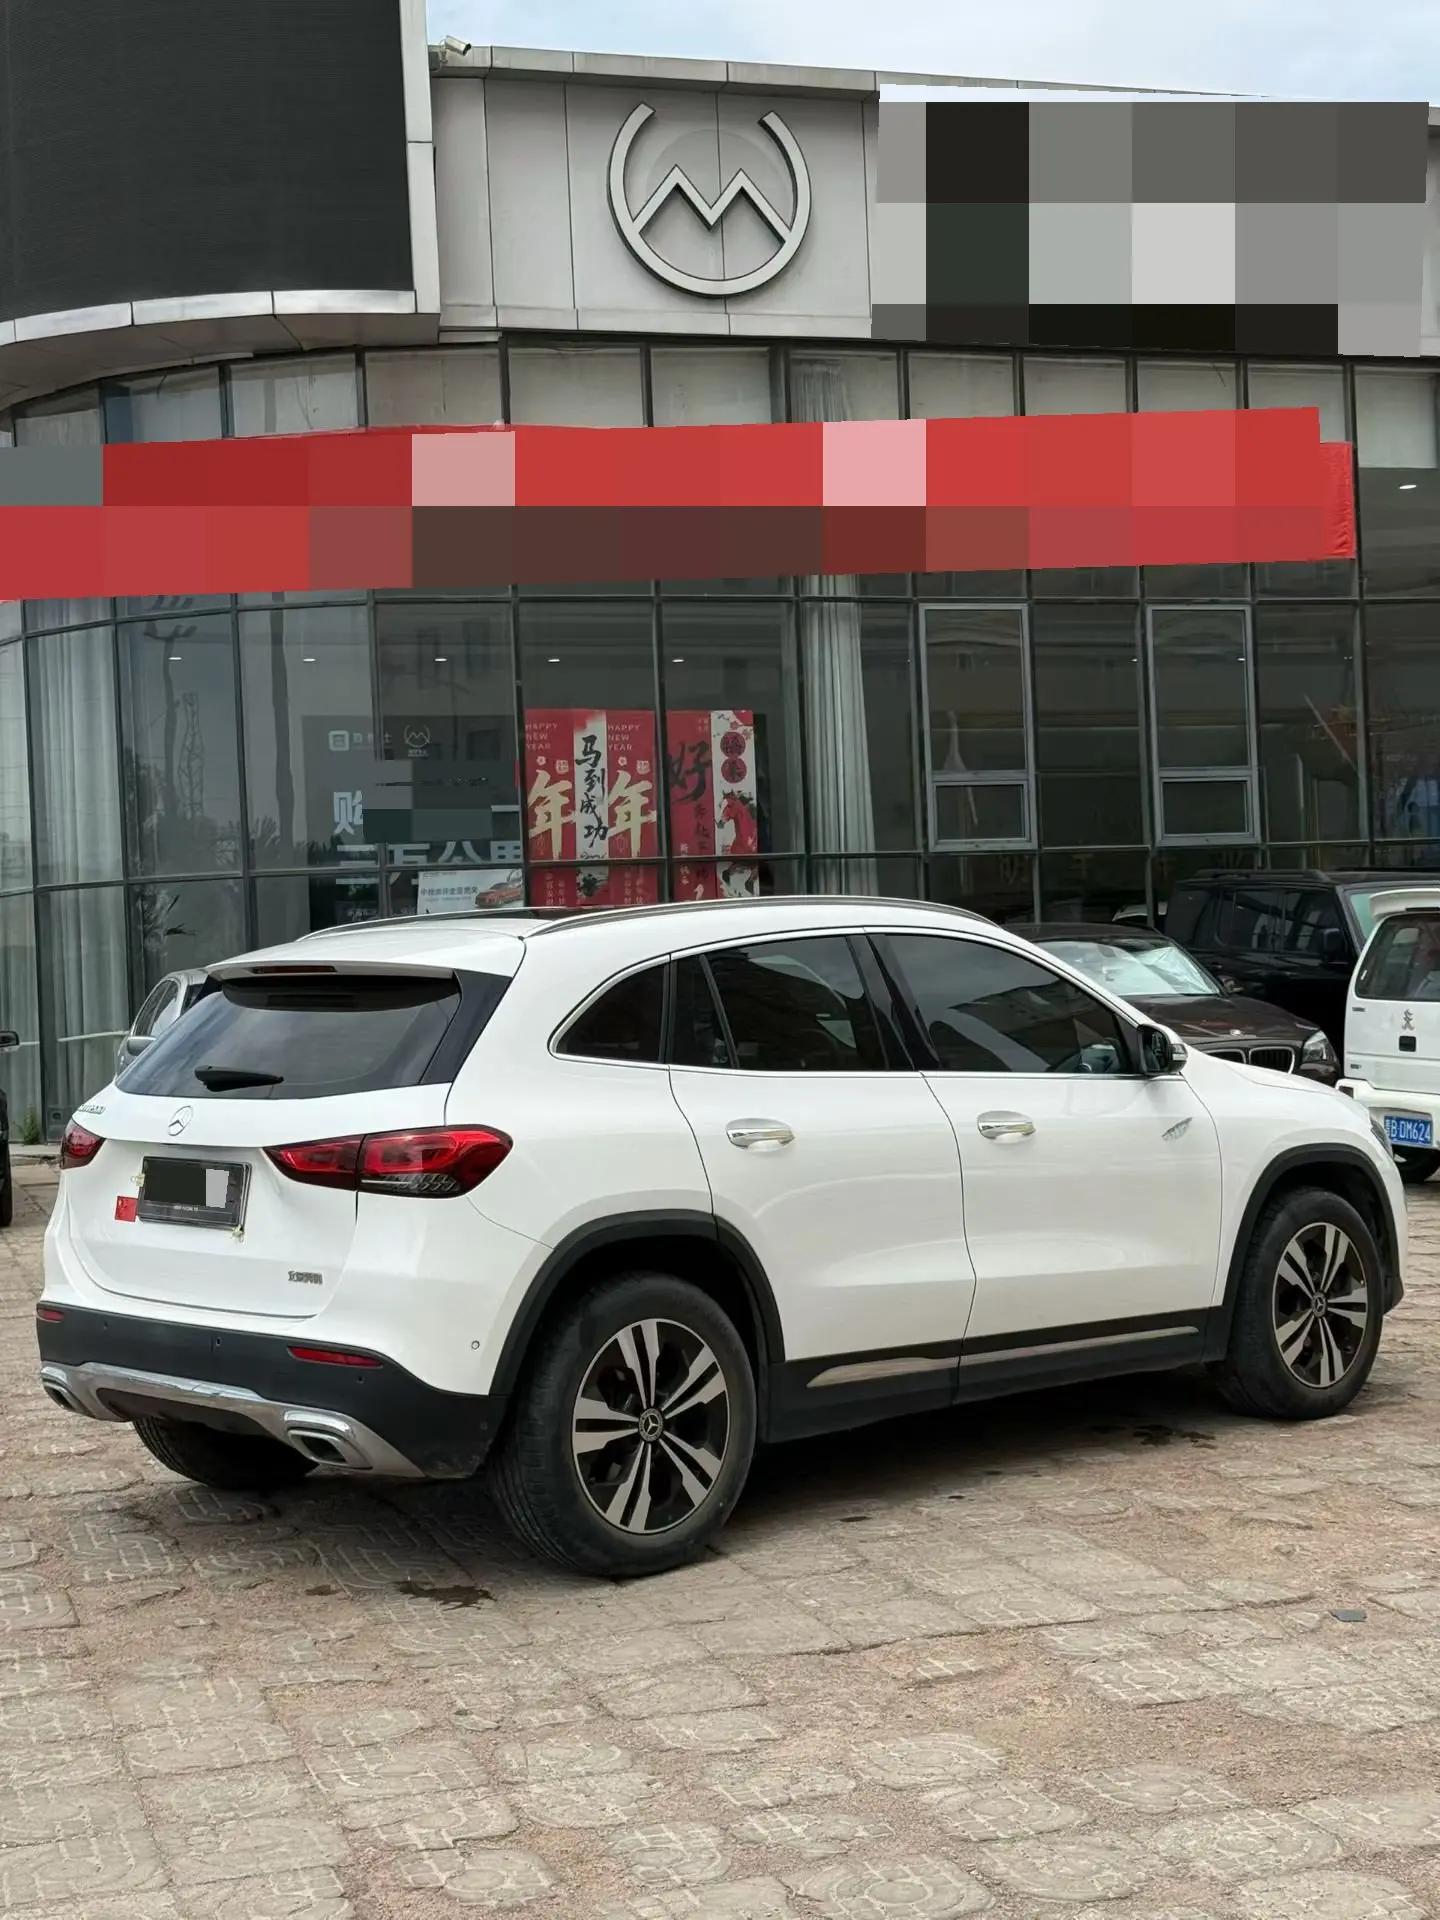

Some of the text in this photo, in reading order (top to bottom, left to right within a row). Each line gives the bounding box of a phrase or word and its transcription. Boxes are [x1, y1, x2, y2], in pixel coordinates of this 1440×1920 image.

[525, 722, 558, 730] HAPPY
[608, 724, 640, 732] HAPPY
[526, 732, 548, 740] NEW
[608, 743, 633, 751] YEAR
[575, 734, 609, 848] 马到成功
[528, 769, 576, 859] 年
[607, 769, 657, 859] 年
